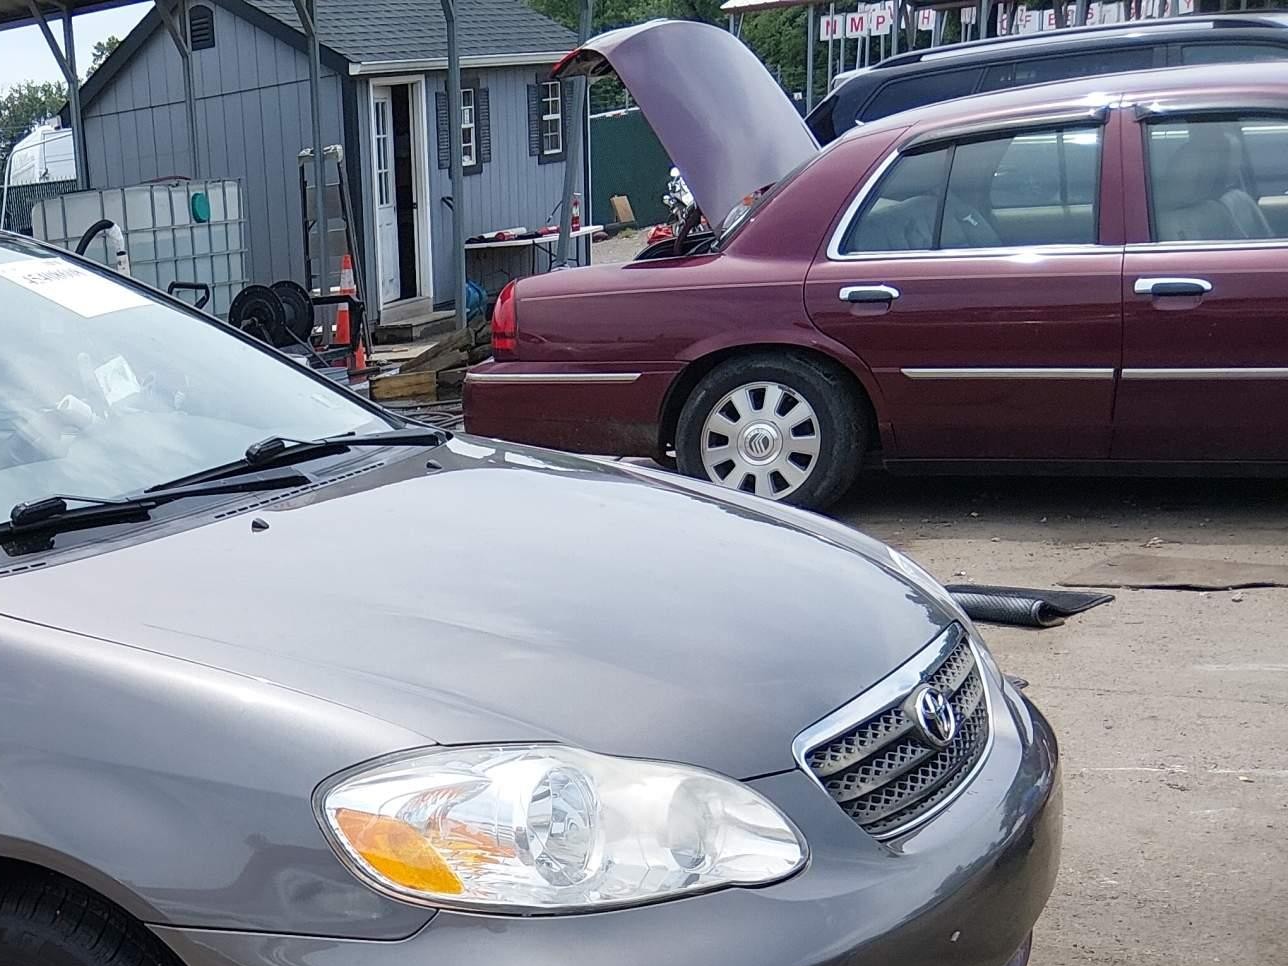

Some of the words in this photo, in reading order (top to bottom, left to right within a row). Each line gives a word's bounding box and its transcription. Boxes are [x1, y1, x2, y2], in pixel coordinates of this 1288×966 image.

[850, 16, 864, 33] M
[875, 15, 886, 31] P
[922, 9, 931, 25] H
[825, 19, 837, 37] N
